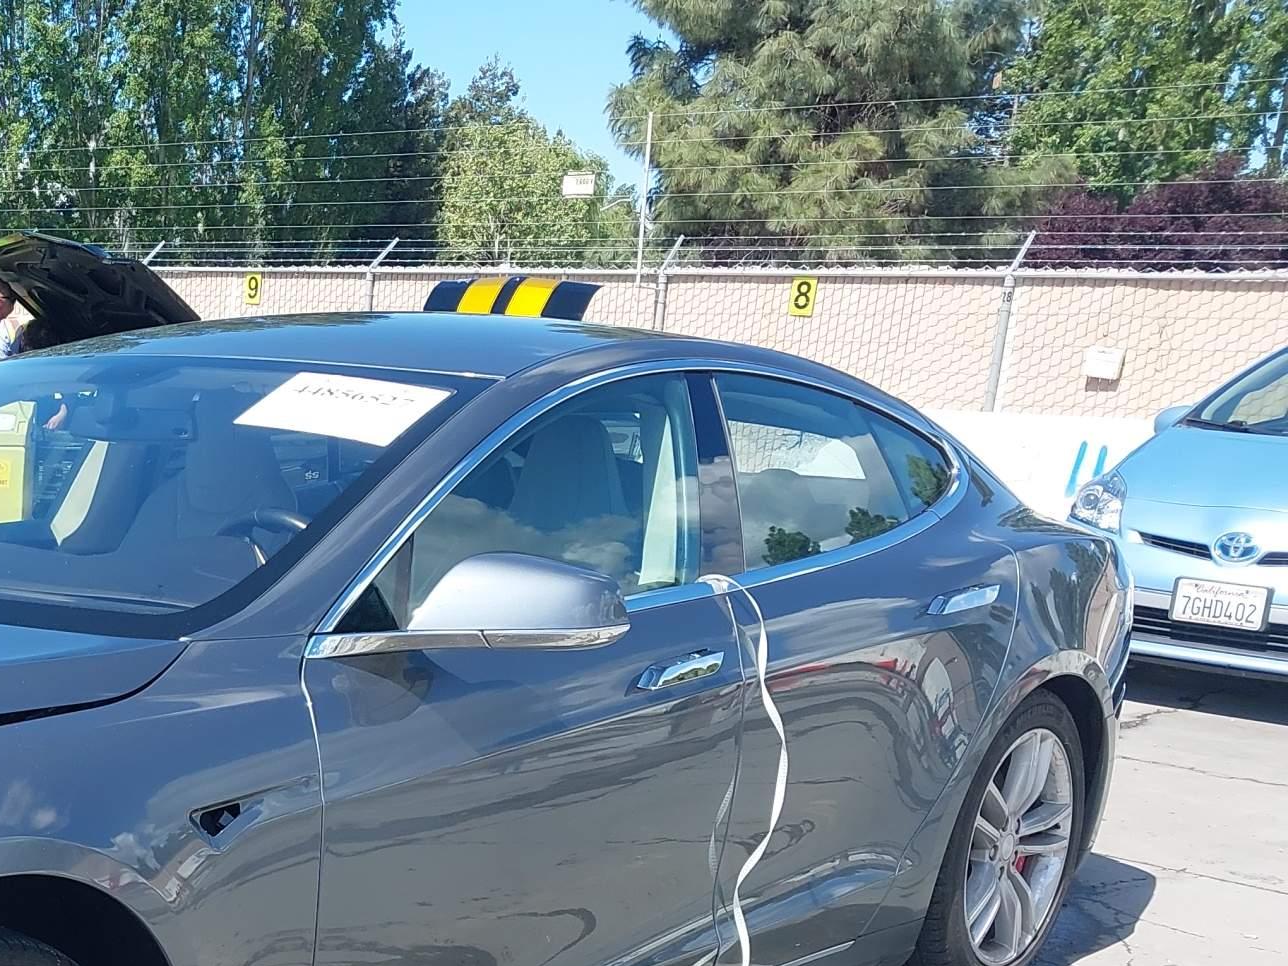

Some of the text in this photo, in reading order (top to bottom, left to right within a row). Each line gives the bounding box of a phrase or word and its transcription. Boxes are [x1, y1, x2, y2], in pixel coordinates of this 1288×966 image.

[247, 276, 258, 299] 9
[794, 281, 812, 310] 8
[1182, 595, 1258, 624] 7GHD402
